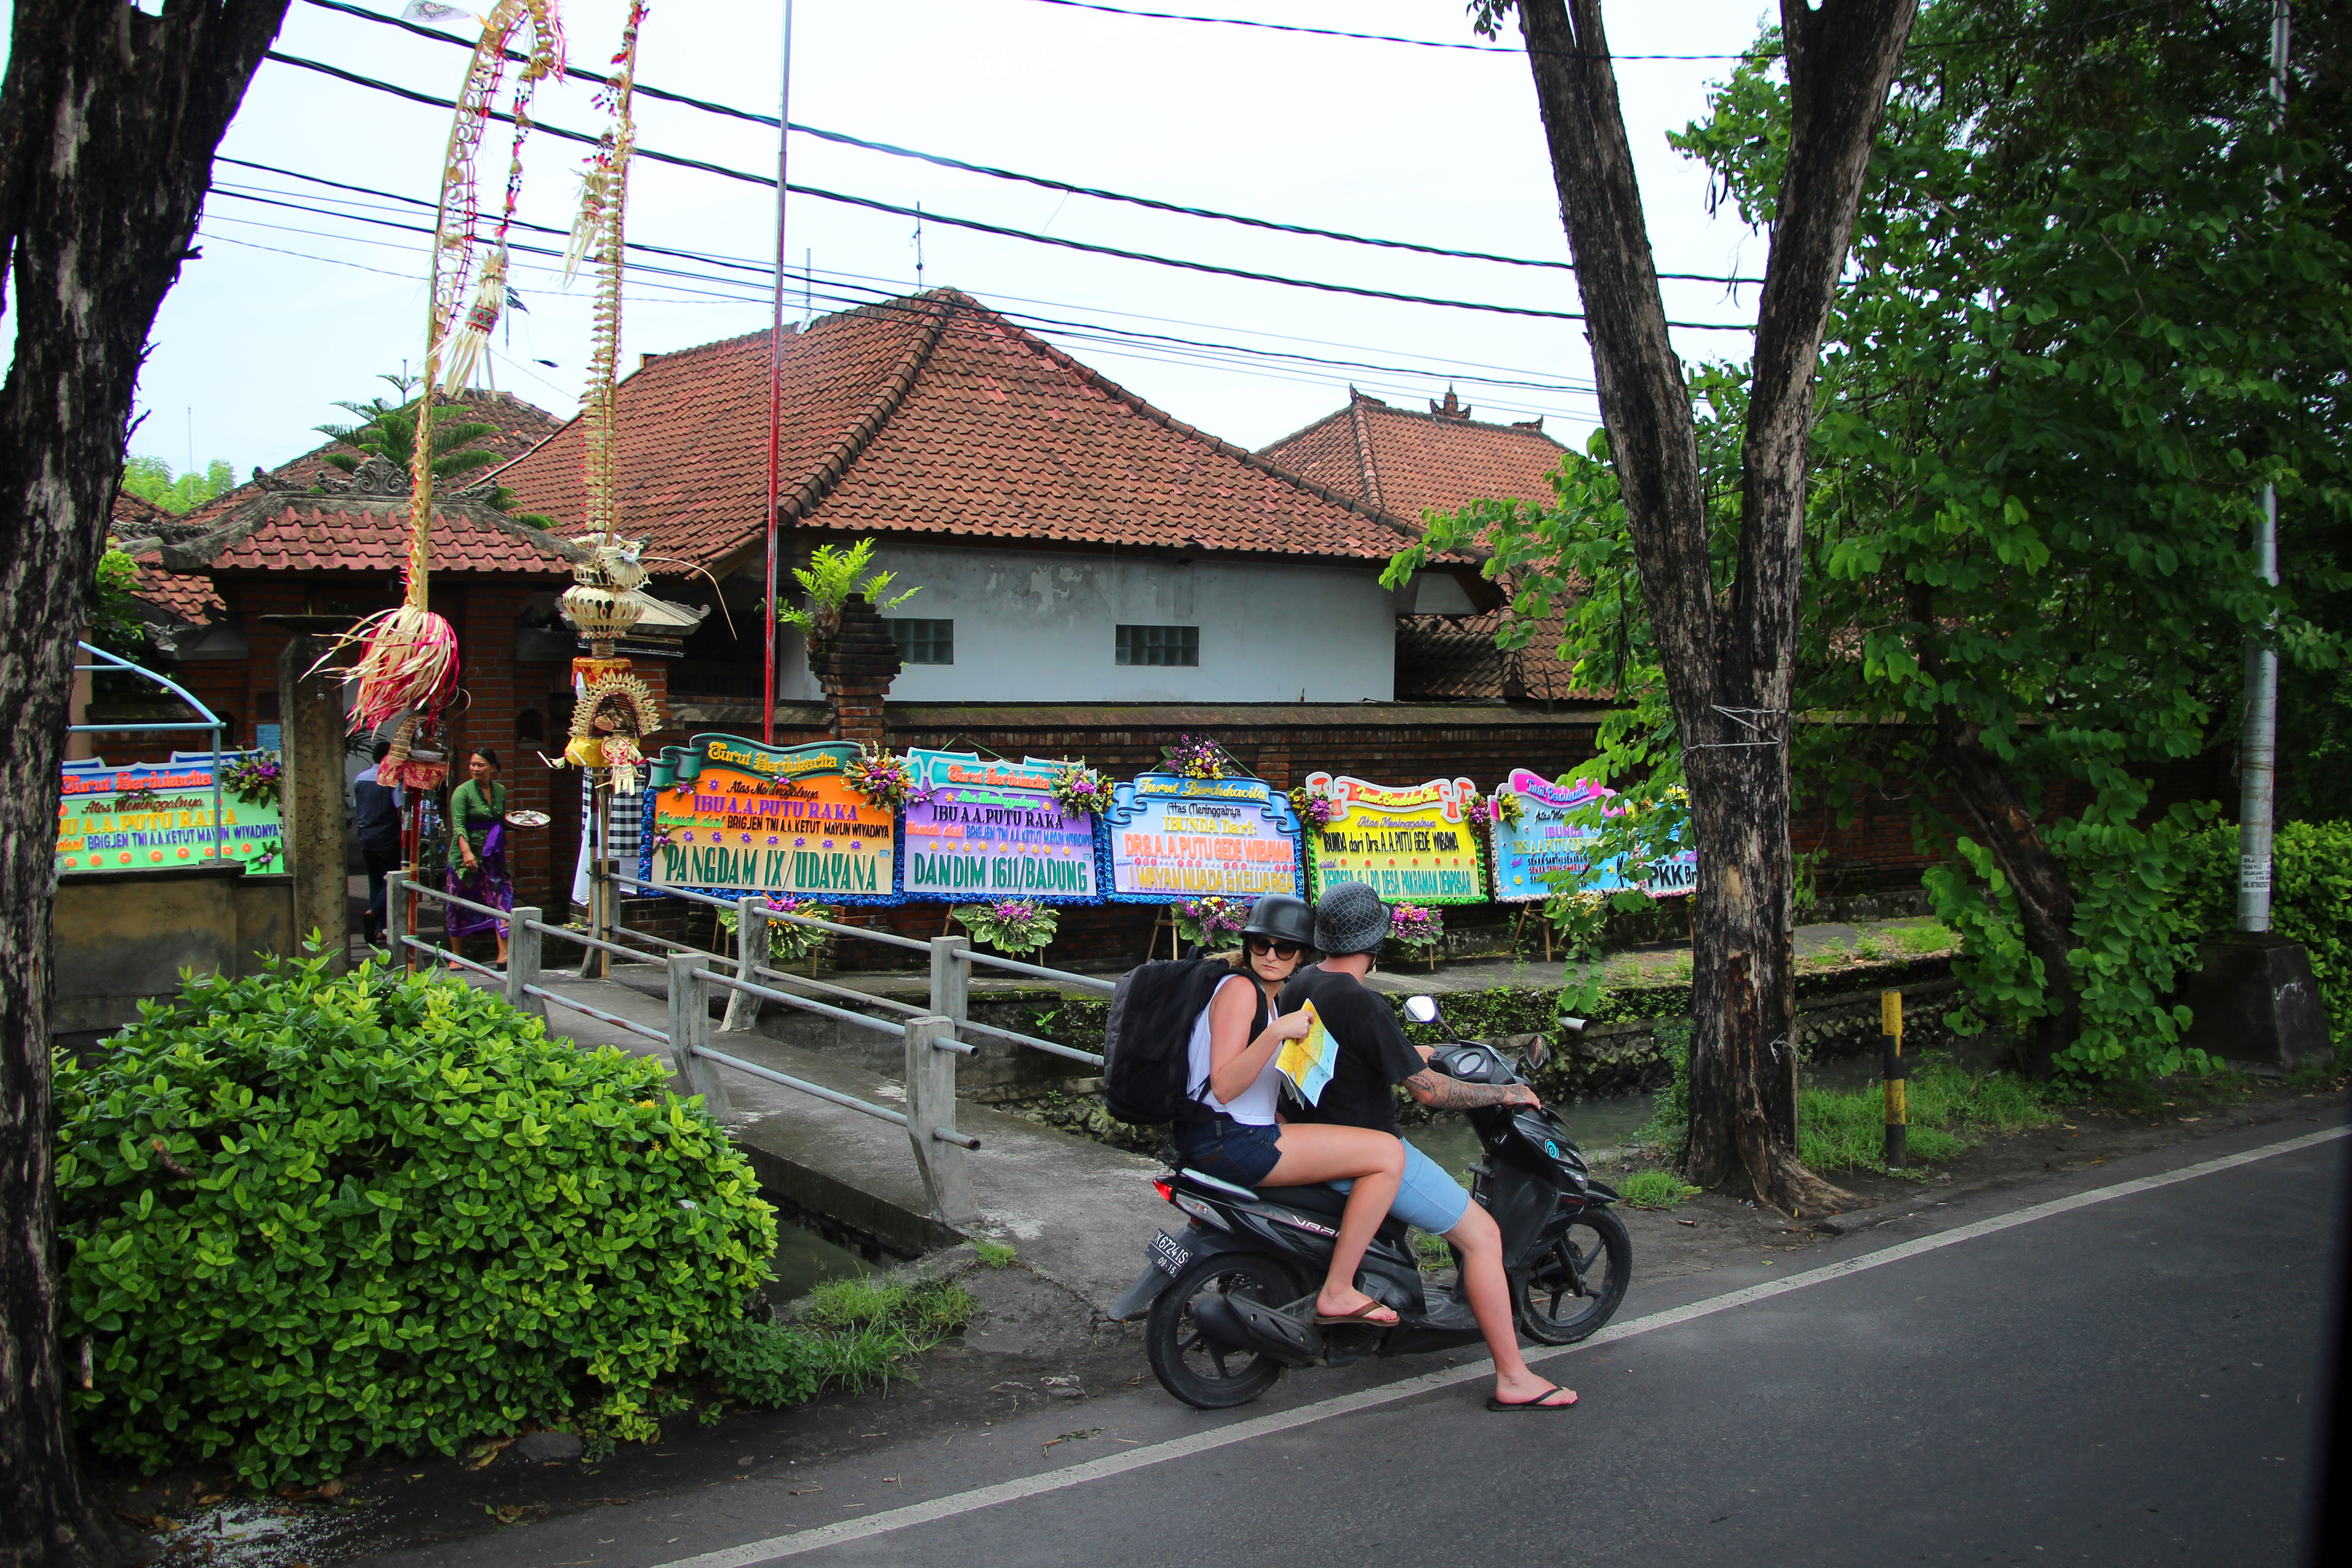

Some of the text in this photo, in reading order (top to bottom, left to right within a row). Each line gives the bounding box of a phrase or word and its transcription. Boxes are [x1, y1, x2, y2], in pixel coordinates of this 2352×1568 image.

[708, 742, 837, 772] Turut Berdukacita
[61, 769, 212, 794] Turut Berdukacita
[727, 780, 750, 794] Atas
[948, 764, 1050, 789] Turut Berdukacita
[1138, 778, 1267, 800] Turut Berdukacita
[1356, 787, 1382, 804] Turut
[1527, 779, 1546, 798] Turut
[82, 800, 112, 813] Atas
[693, 795, 725, 812] IBU
[808, 803, 858, 820] RAKA
[956, 790, 1040, 811] Atas Meninggalnya
[1167, 802, 1241, 817] Atas Meninggalnya
[700, 814, 725, 828] dari
[765, 817, 779, 831] TNI
[824, 822, 850, 835] MAYUN
[852, 823, 889, 838] WIYADNYA
[932, 805, 958, 822] IBU
[1025, 810, 1064, 829] RAKA
[1162, 816, 1258, 835] IBUNDA Dari:
[1357, 815, 1436, 829] Atas Meninggalnya
[132, 831, 147, 847] TNI
[233, 823, 279, 839] WIYADNYA
[942, 823, 965, 838] dari
[996, 827, 1007, 840] TNI
[1323, 832, 1347, 852] IBUNDA
[1349, 832, 1363, 853] dari
[1413, 831, 1431, 851] GEDE
[1432, 832, 1459, 852] WIBAWA
[1544, 825, 1584, 837] IBUNDA
[1214, 837, 1243, 860] GEDE
[1243, 839, 1293, 862] WIBAWA
[666, 844, 877, 890] PANGDAM IX/UDAYANA
[915, 852, 1087, 893] DANDIM 1611/BADUNG
[1318, 858, 1336, 867] dari
[1129, 866, 1295, 894] I WAYAN NUADA & KELUARGA
[1381, 870, 1400, 894] DESA
[1438, 870, 1471, 894] DENPASAR
[1647, 864, 1684, 887] PKK
[1292, 1215, 1339, 1237] VARI
